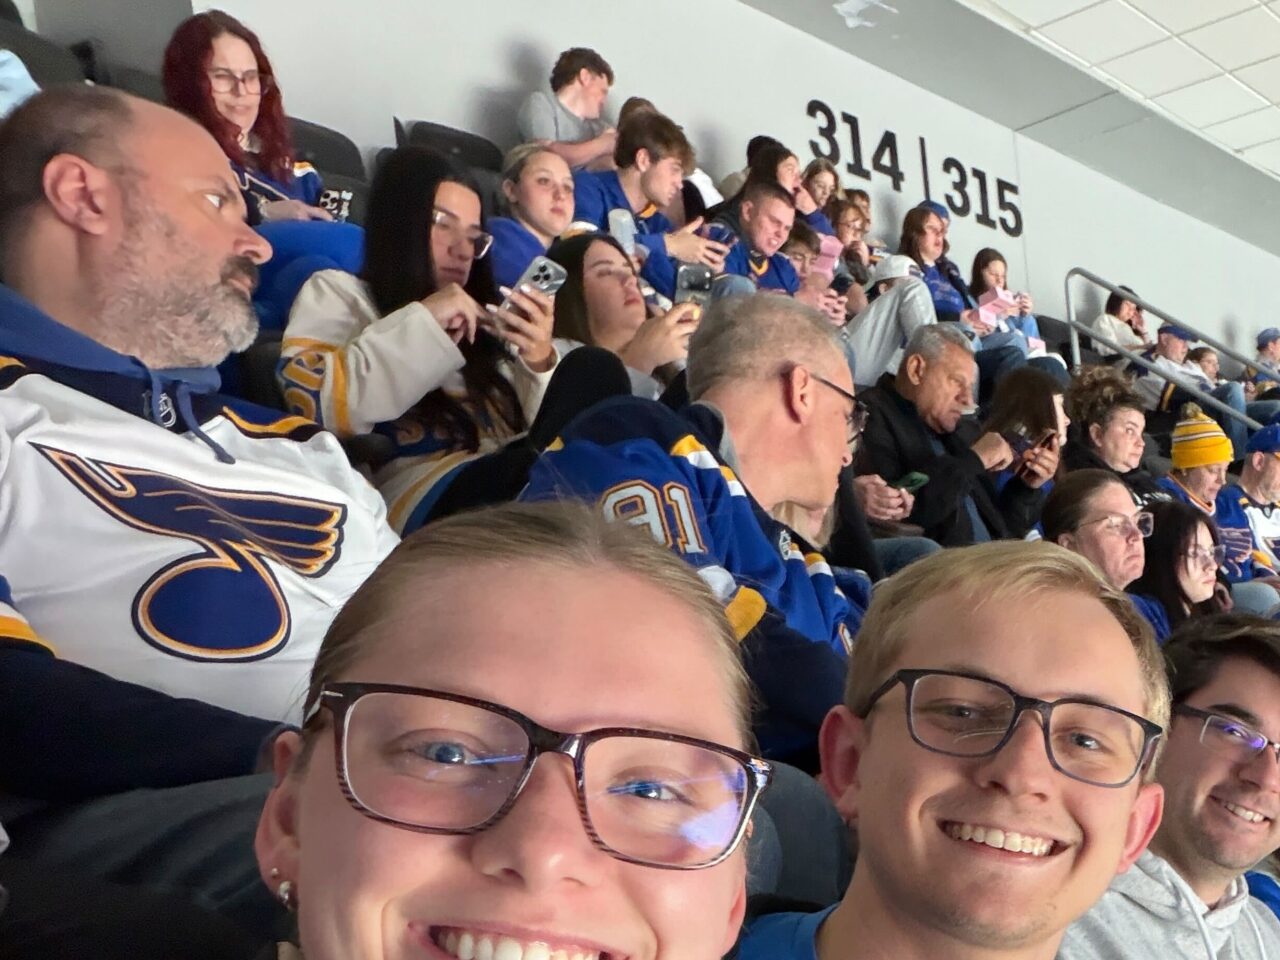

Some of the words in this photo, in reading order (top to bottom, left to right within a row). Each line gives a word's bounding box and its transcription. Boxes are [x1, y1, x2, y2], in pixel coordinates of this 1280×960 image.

[806, 99, 904, 193] 314
[942, 157, 1024, 238] 315
[600, 480, 708, 554] 91
